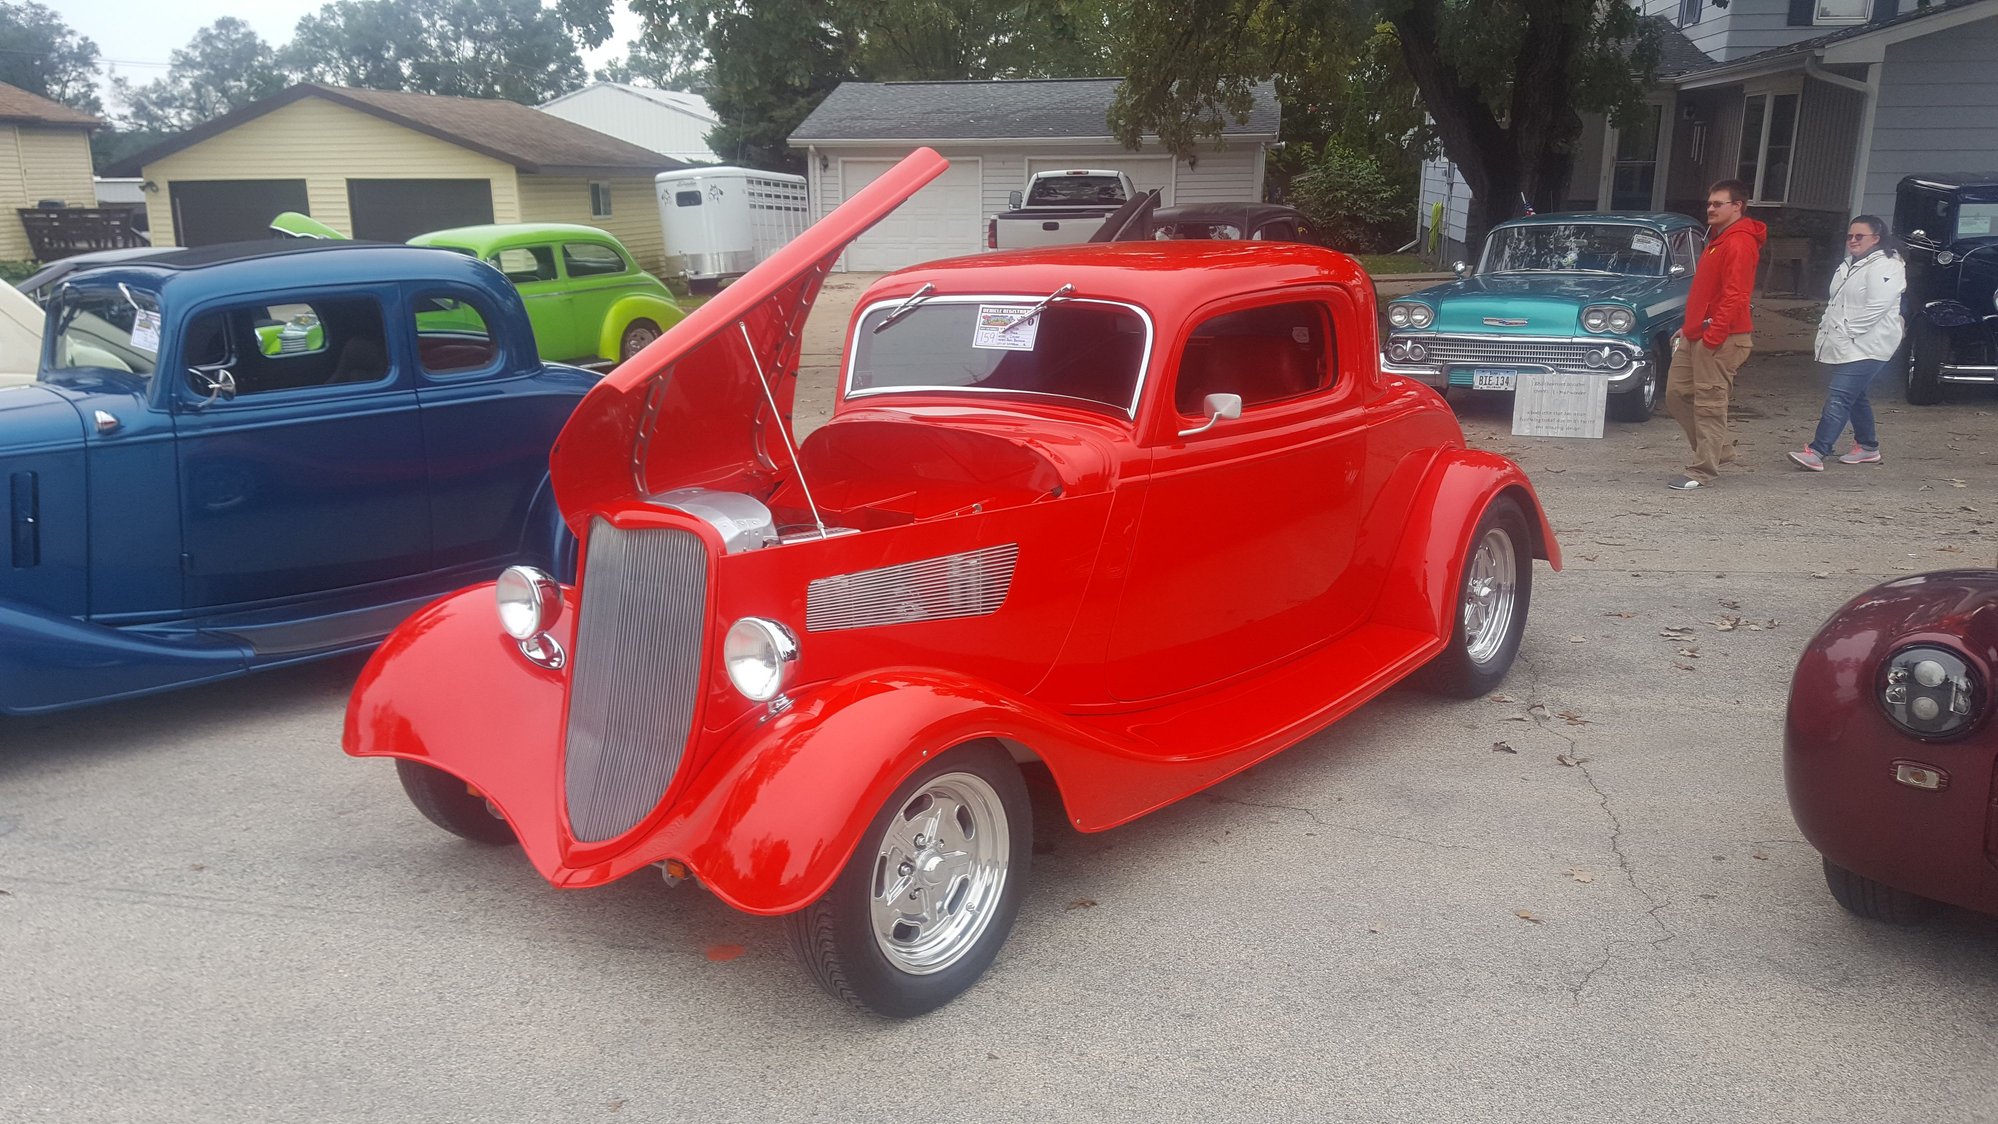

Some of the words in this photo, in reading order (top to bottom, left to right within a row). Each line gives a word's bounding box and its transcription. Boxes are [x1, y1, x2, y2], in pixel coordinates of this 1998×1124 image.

[980, 331, 995, 343] 159
[1479, 375, 1493, 386] BIE
[1495, 376, 1510, 386] 134
